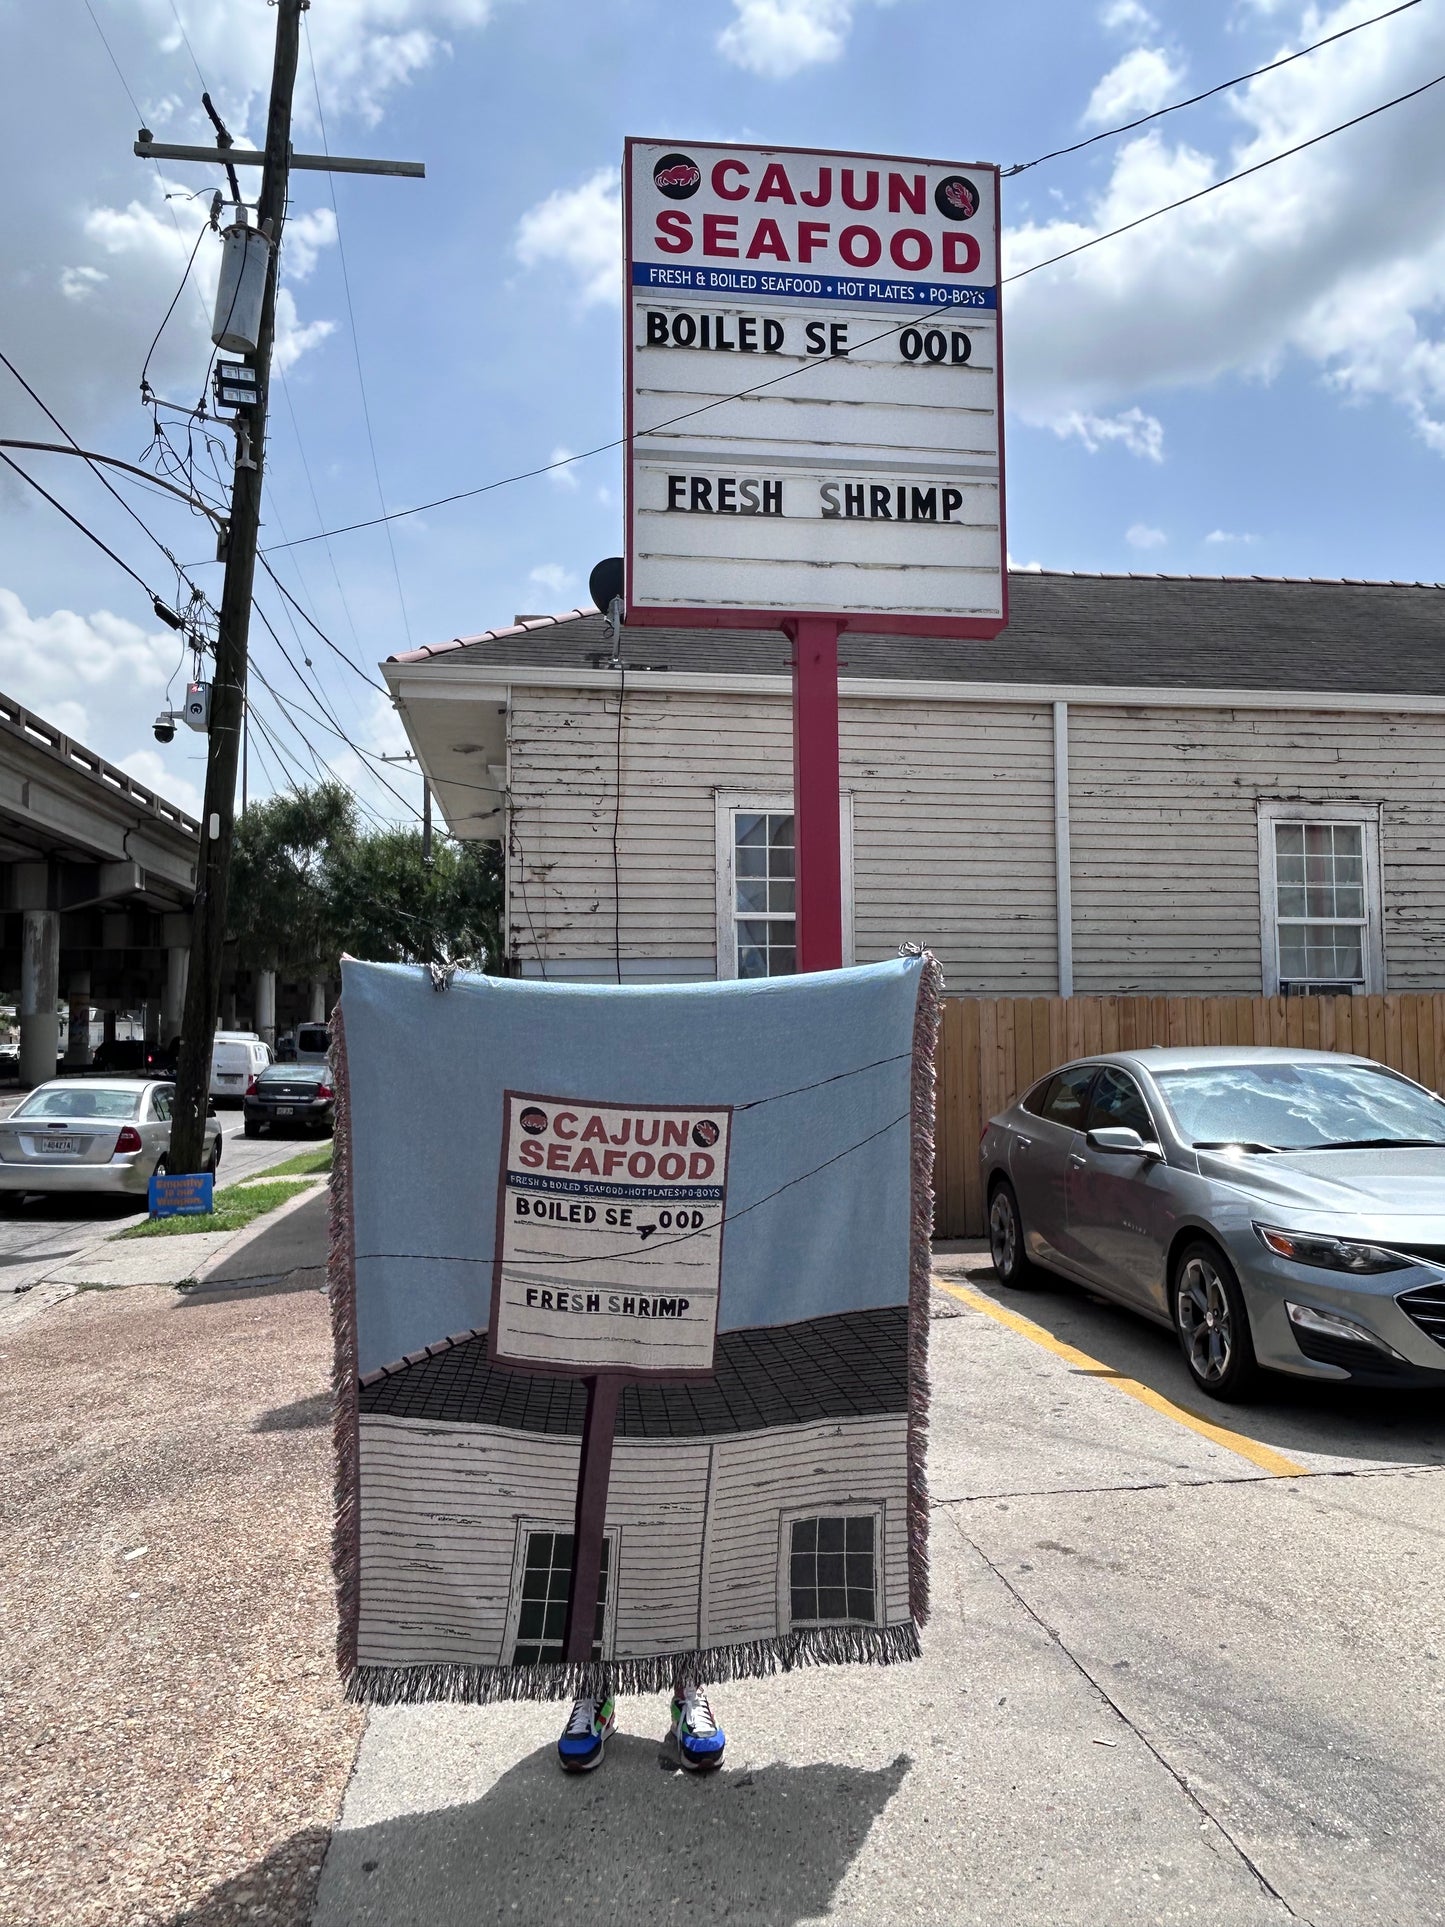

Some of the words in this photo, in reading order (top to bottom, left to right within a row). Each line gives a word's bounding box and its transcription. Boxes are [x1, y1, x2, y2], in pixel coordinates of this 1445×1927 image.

[711, 159, 927, 215] CAJUN
[654, 210, 981, 273] SEAFOOD
[650, 268, 692, 285] FRESH
[696, 272, 706, 286] &
[710, 272, 757, 289] BOILED
[761, 276, 822, 294] SEAFOOD
[837, 281, 866, 297] HOT
[869, 284, 915, 300] PLATES
[930, 288, 985, 305] PO-BOYS
[647, 311, 785, 352] BOILED
[805, 321, 849, 356] SE
[900, 328, 972, 362] OOD
[667, 475, 783, 515] FRESH
[820, 482, 963, 521] SHRIMP
[553, 1112, 690, 1147] CAJUN
[519, 1139, 715, 1180] SEAFOOD
[510, 1175, 539, 1186] FRESH
[549, 1181, 581, 1191] BOILED
[583, 1184, 623, 1195] SEAFOOD
[628, 1187, 647, 1196] HOT
[647, 1188, 678, 1197] PLATES
[516, 1197, 597, 1224] BOILED
[605, 1208, 633, 1226] SE
[659, 1211, 704, 1229] OOD
[526, 1289, 600, 1313] FRESH
[608, 1295, 690, 1318] SHRIMP
